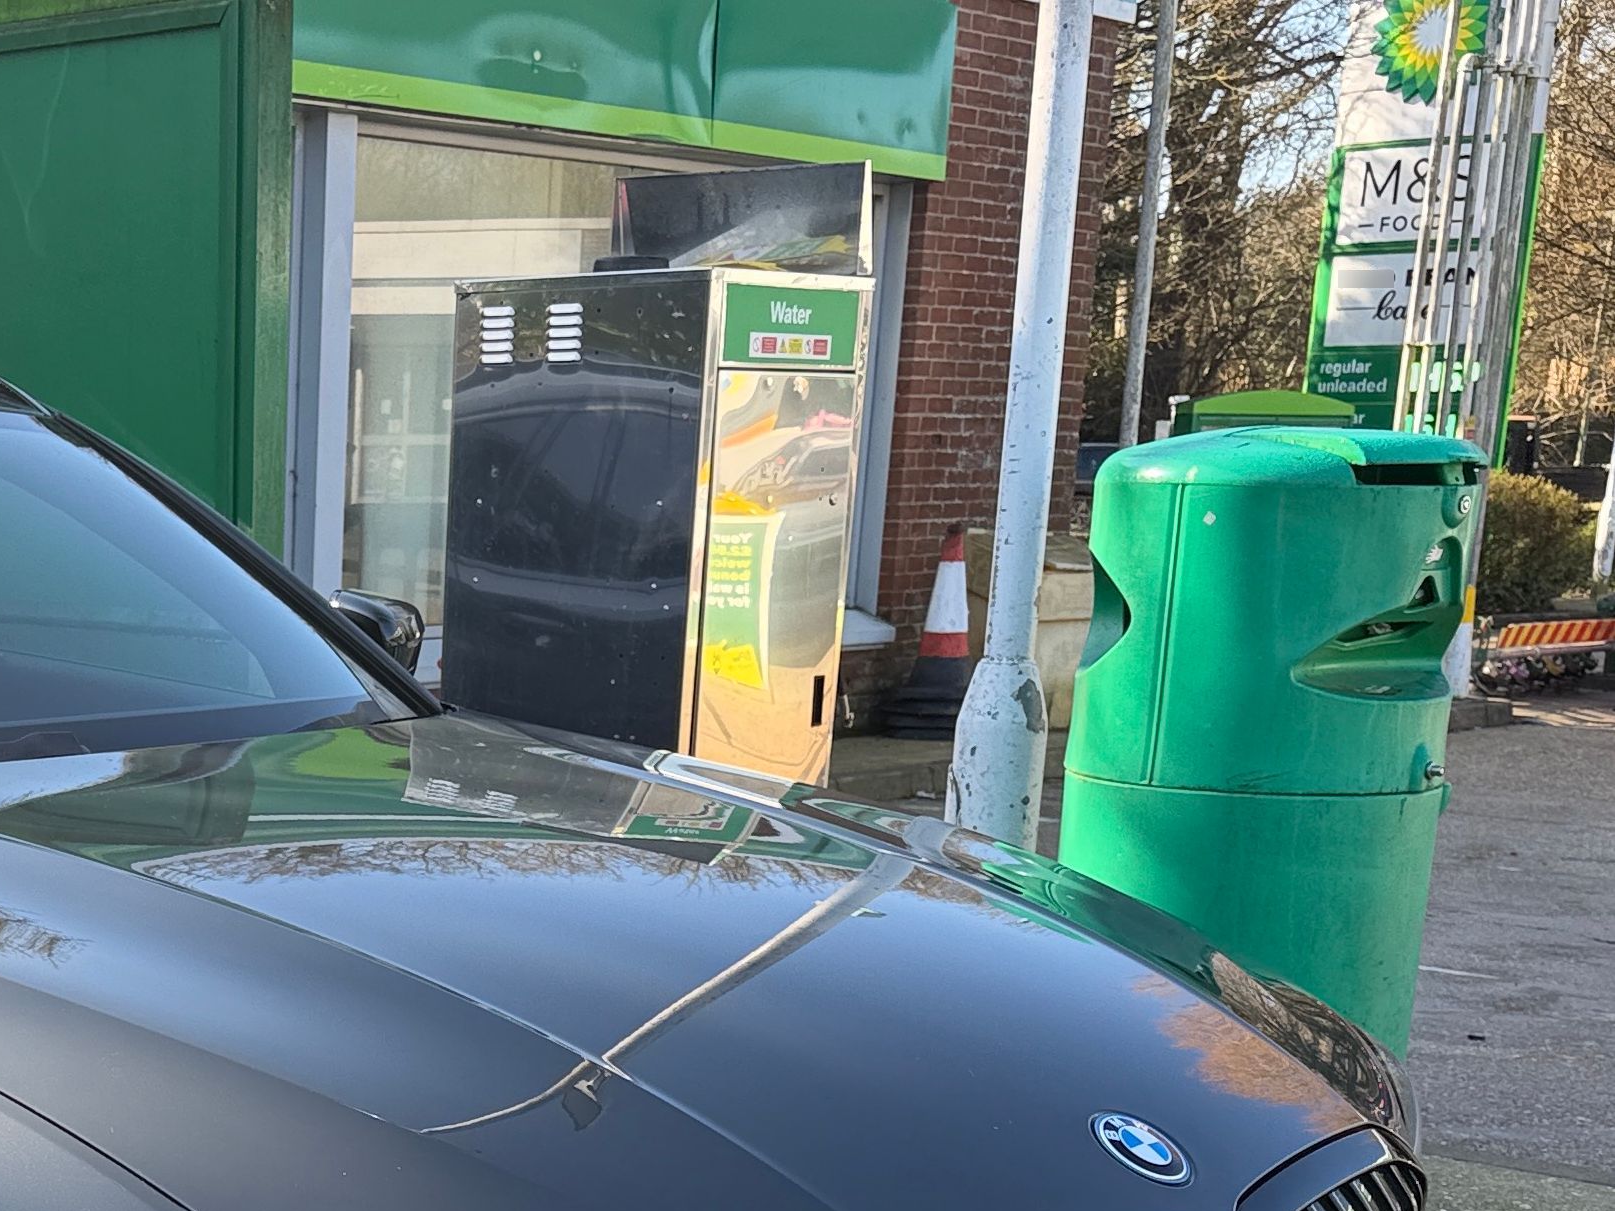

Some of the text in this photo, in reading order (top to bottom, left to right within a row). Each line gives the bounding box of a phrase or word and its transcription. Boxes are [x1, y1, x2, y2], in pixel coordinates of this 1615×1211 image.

[770, 301, 812, 325] Water
[1372, 290, 1430, 321] Ca
[1320, 358, 1373, 378] regular
[1317, 378, 1387, 394] unleaded
